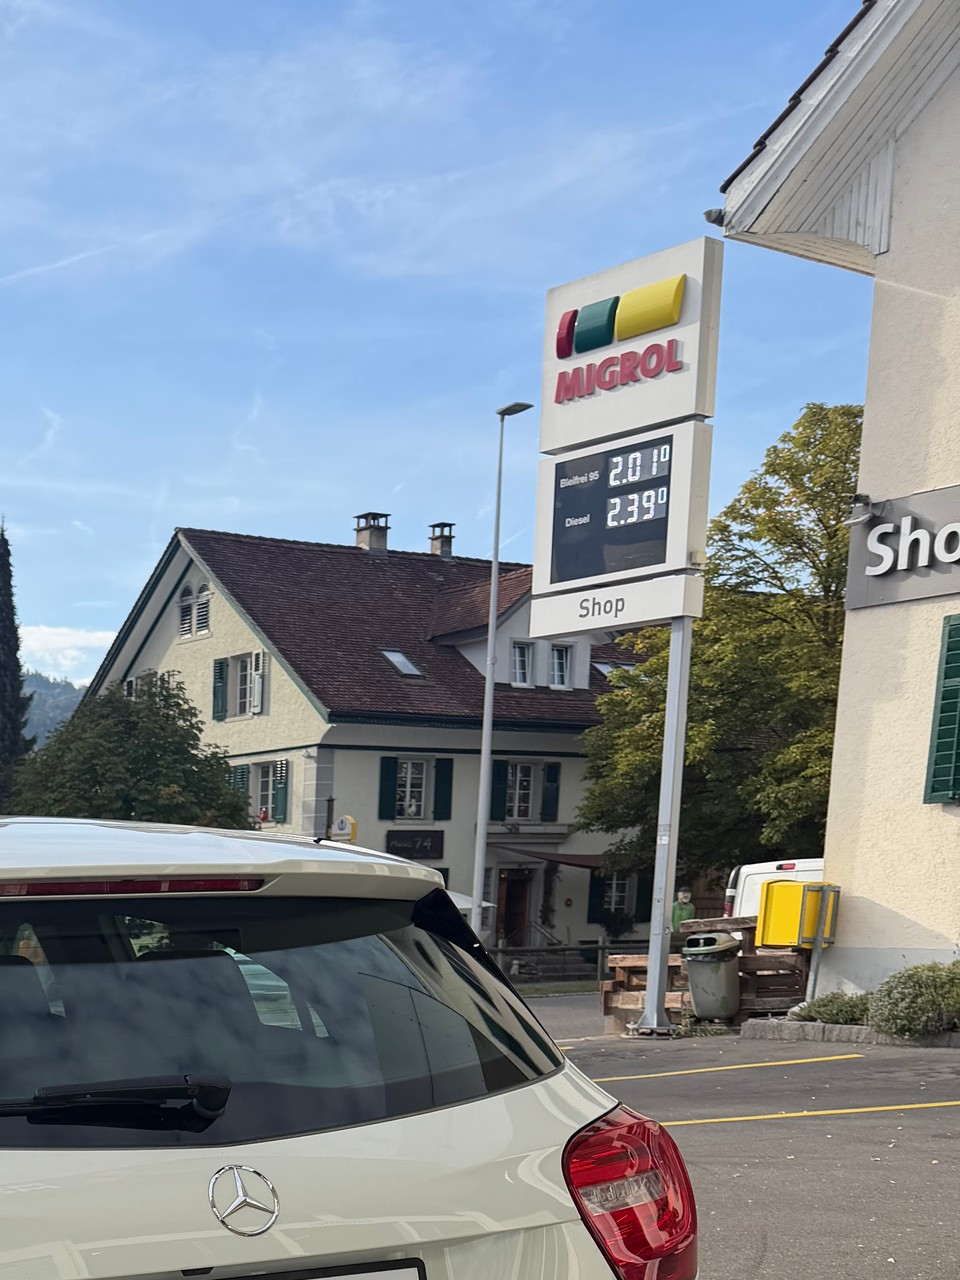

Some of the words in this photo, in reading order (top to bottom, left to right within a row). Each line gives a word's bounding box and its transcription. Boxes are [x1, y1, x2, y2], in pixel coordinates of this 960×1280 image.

[554, 338, 683, 405] MIGROL
[559, 472, 588, 488] Bleifrei
[588, 470, 600, 481] 95
[564, 513, 591, 528] Diesel
[864, 515, 960, 577] Sho
[578, 596, 625, 619] Shop
